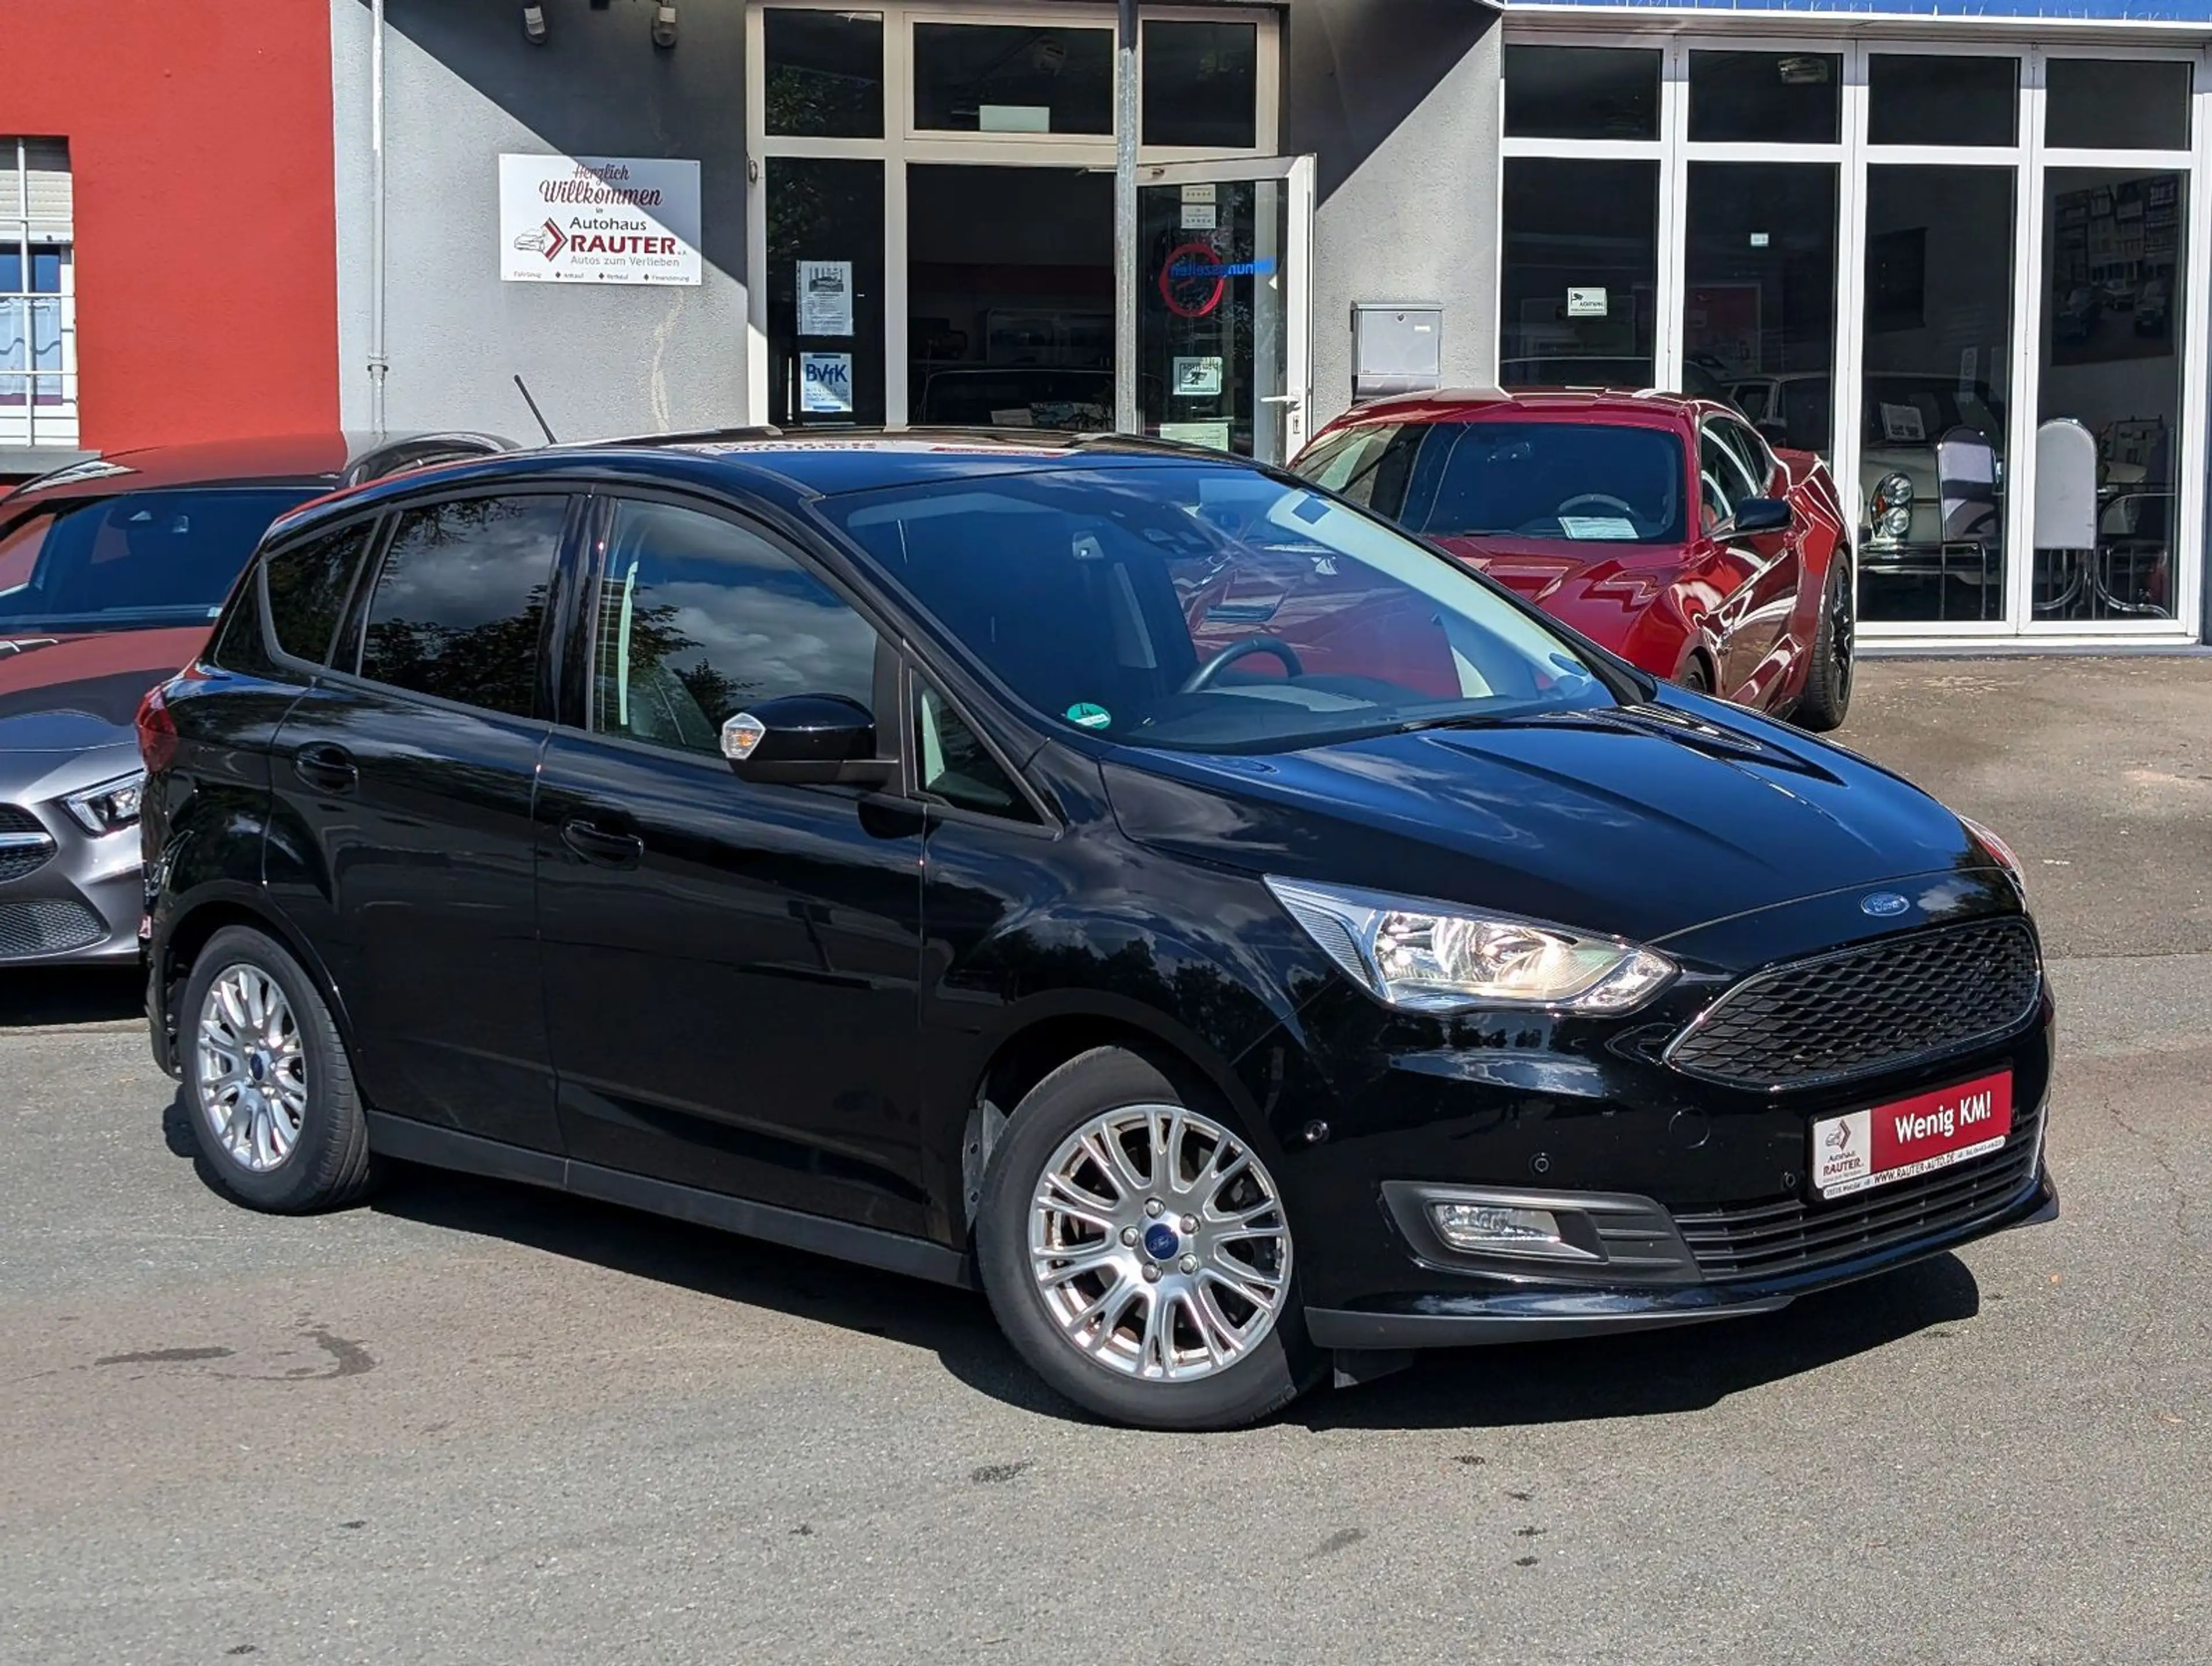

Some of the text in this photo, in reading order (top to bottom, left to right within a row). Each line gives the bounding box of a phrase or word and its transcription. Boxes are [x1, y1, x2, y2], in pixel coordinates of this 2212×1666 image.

[572, 164, 630, 186] Herzlich
[539, 180, 663, 207] Willkommen
[569, 216, 647, 230] Autohaus
[571, 234, 676, 255] RAUTER
[571, 255, 680, 267] Autos zum Verlieben
[1895, 1090, 1991, 1144] Wenig KM!
[1823, 1157, 1861, 1177] RAUTER
